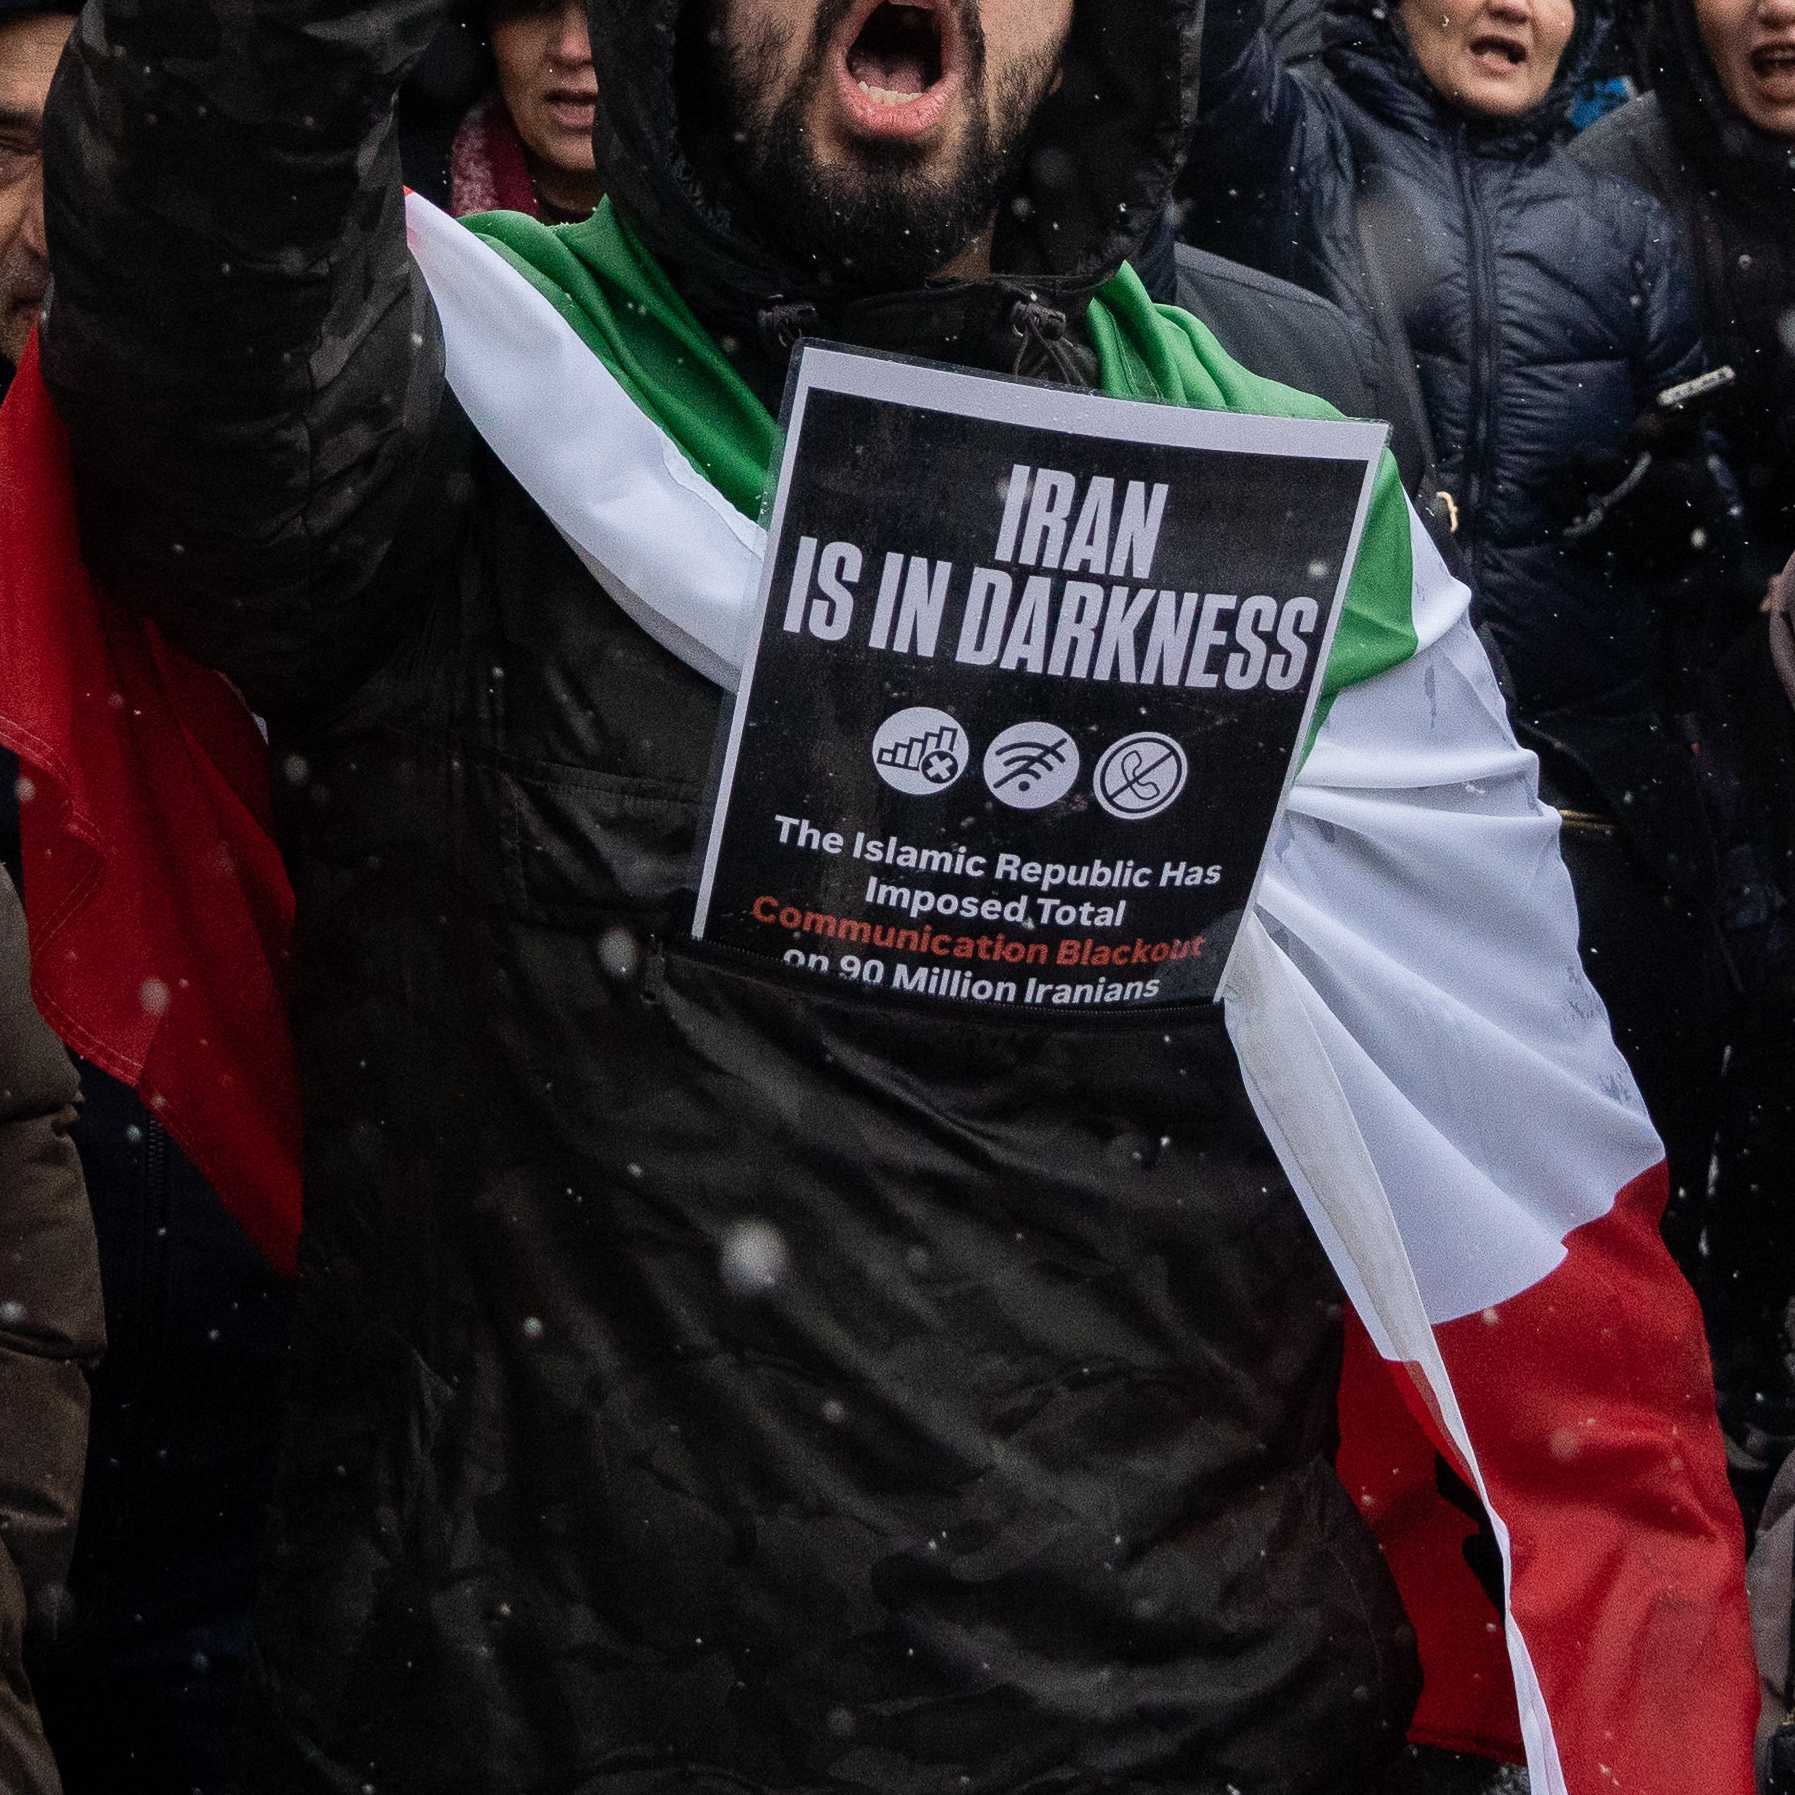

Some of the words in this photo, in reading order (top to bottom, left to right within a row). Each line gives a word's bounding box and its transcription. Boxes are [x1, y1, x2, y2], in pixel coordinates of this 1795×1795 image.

[993, 464, 1169, 579] IRAN
[782, 535, 862, 642] IS
[869, 551, 953, 658] IN
[955, 566, 1320, 692] DARKNESS
[774, 814, 844, 856] The
[852, 831, 986, 878] Islamic
[994, 853, 1153, 892] Republic
[1159, 859, 1222, 888] Has
[751, 895, 1049, 965] Communication
[1056, 936, 1205, 966] Blackout
[865, 876, 1027, 928] Imposed
[1036, 898, 1127, 928] Total
[782, 949, 831, 974] on
[839, 955, 886, 985] 90
[892, 963, 1017, 1003] Million
[1024, 975, 1160, 1004] Iranians
